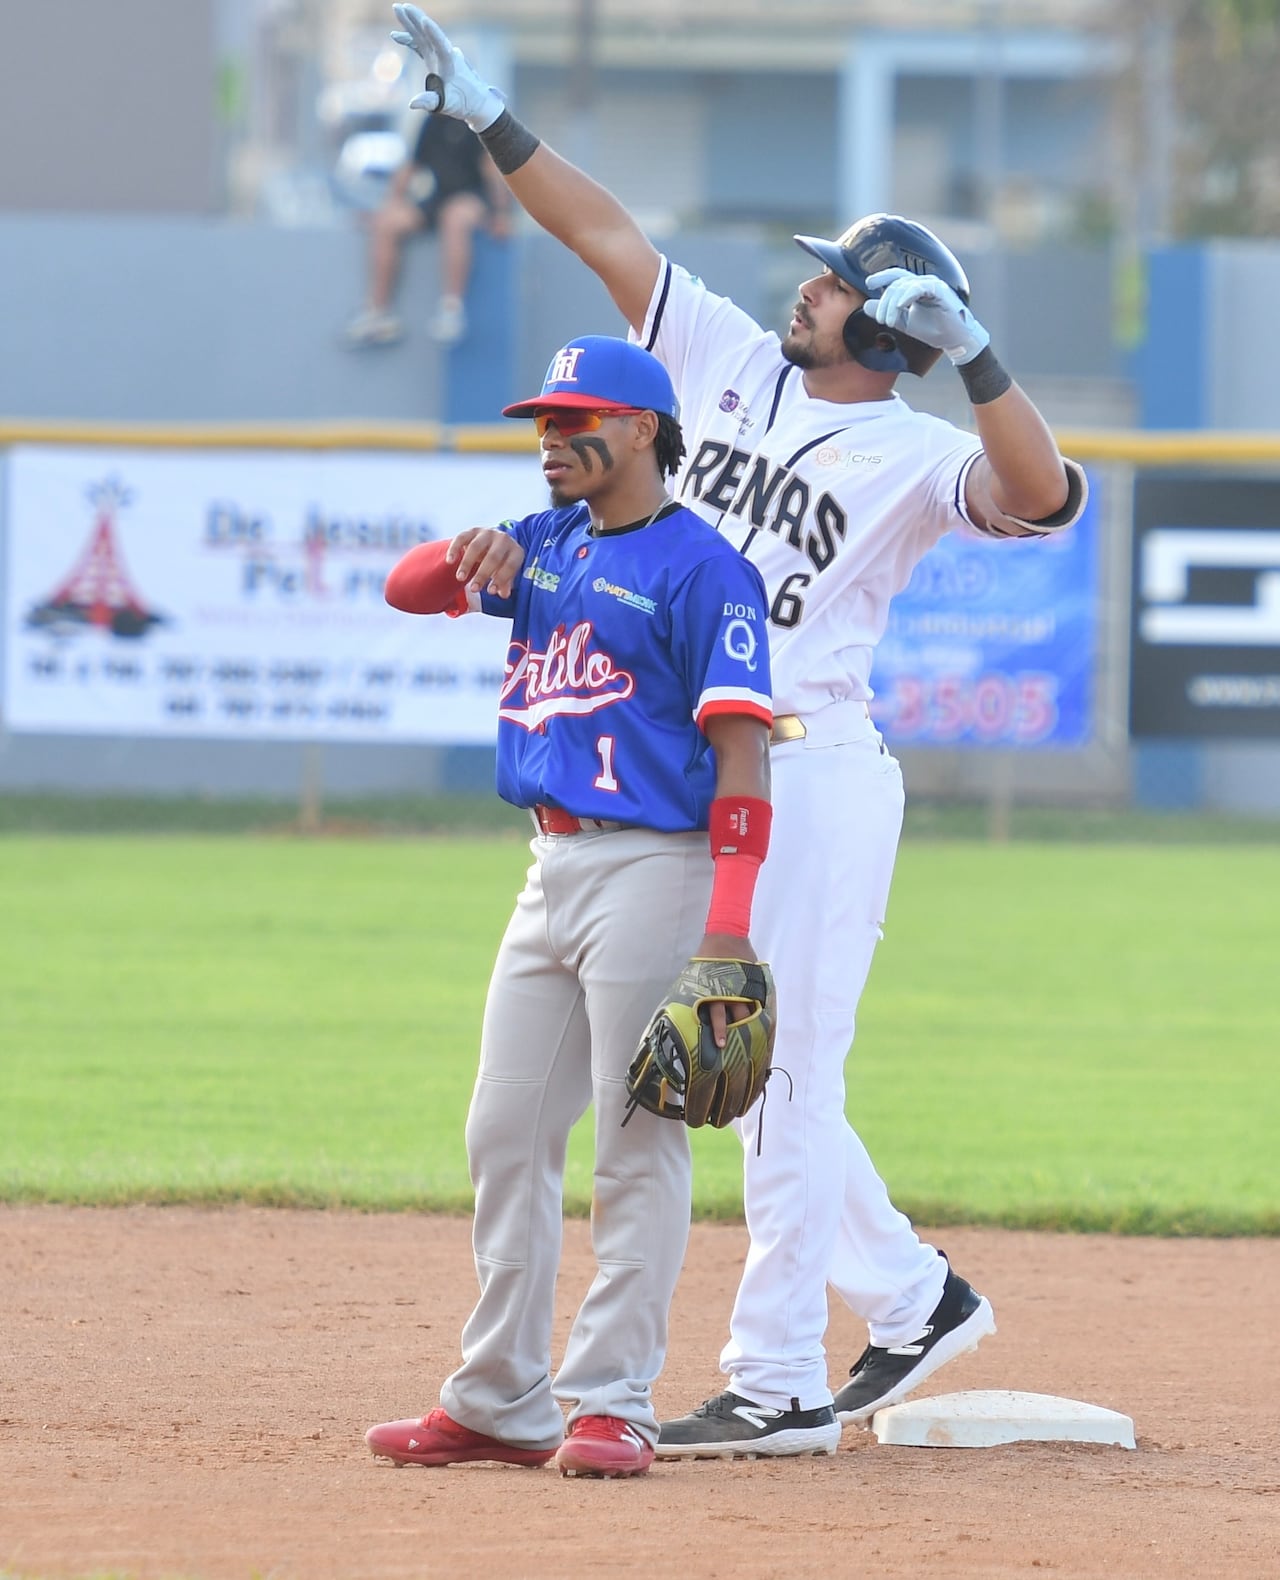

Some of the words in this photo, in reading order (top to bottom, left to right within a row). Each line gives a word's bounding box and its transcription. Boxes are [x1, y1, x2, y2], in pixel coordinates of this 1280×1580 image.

[722, 602, 757, 620] DON
[769, 572, 813, 631] 6
[723, 618, 758, 673] Q
[594, 736, 618, 791] 1
